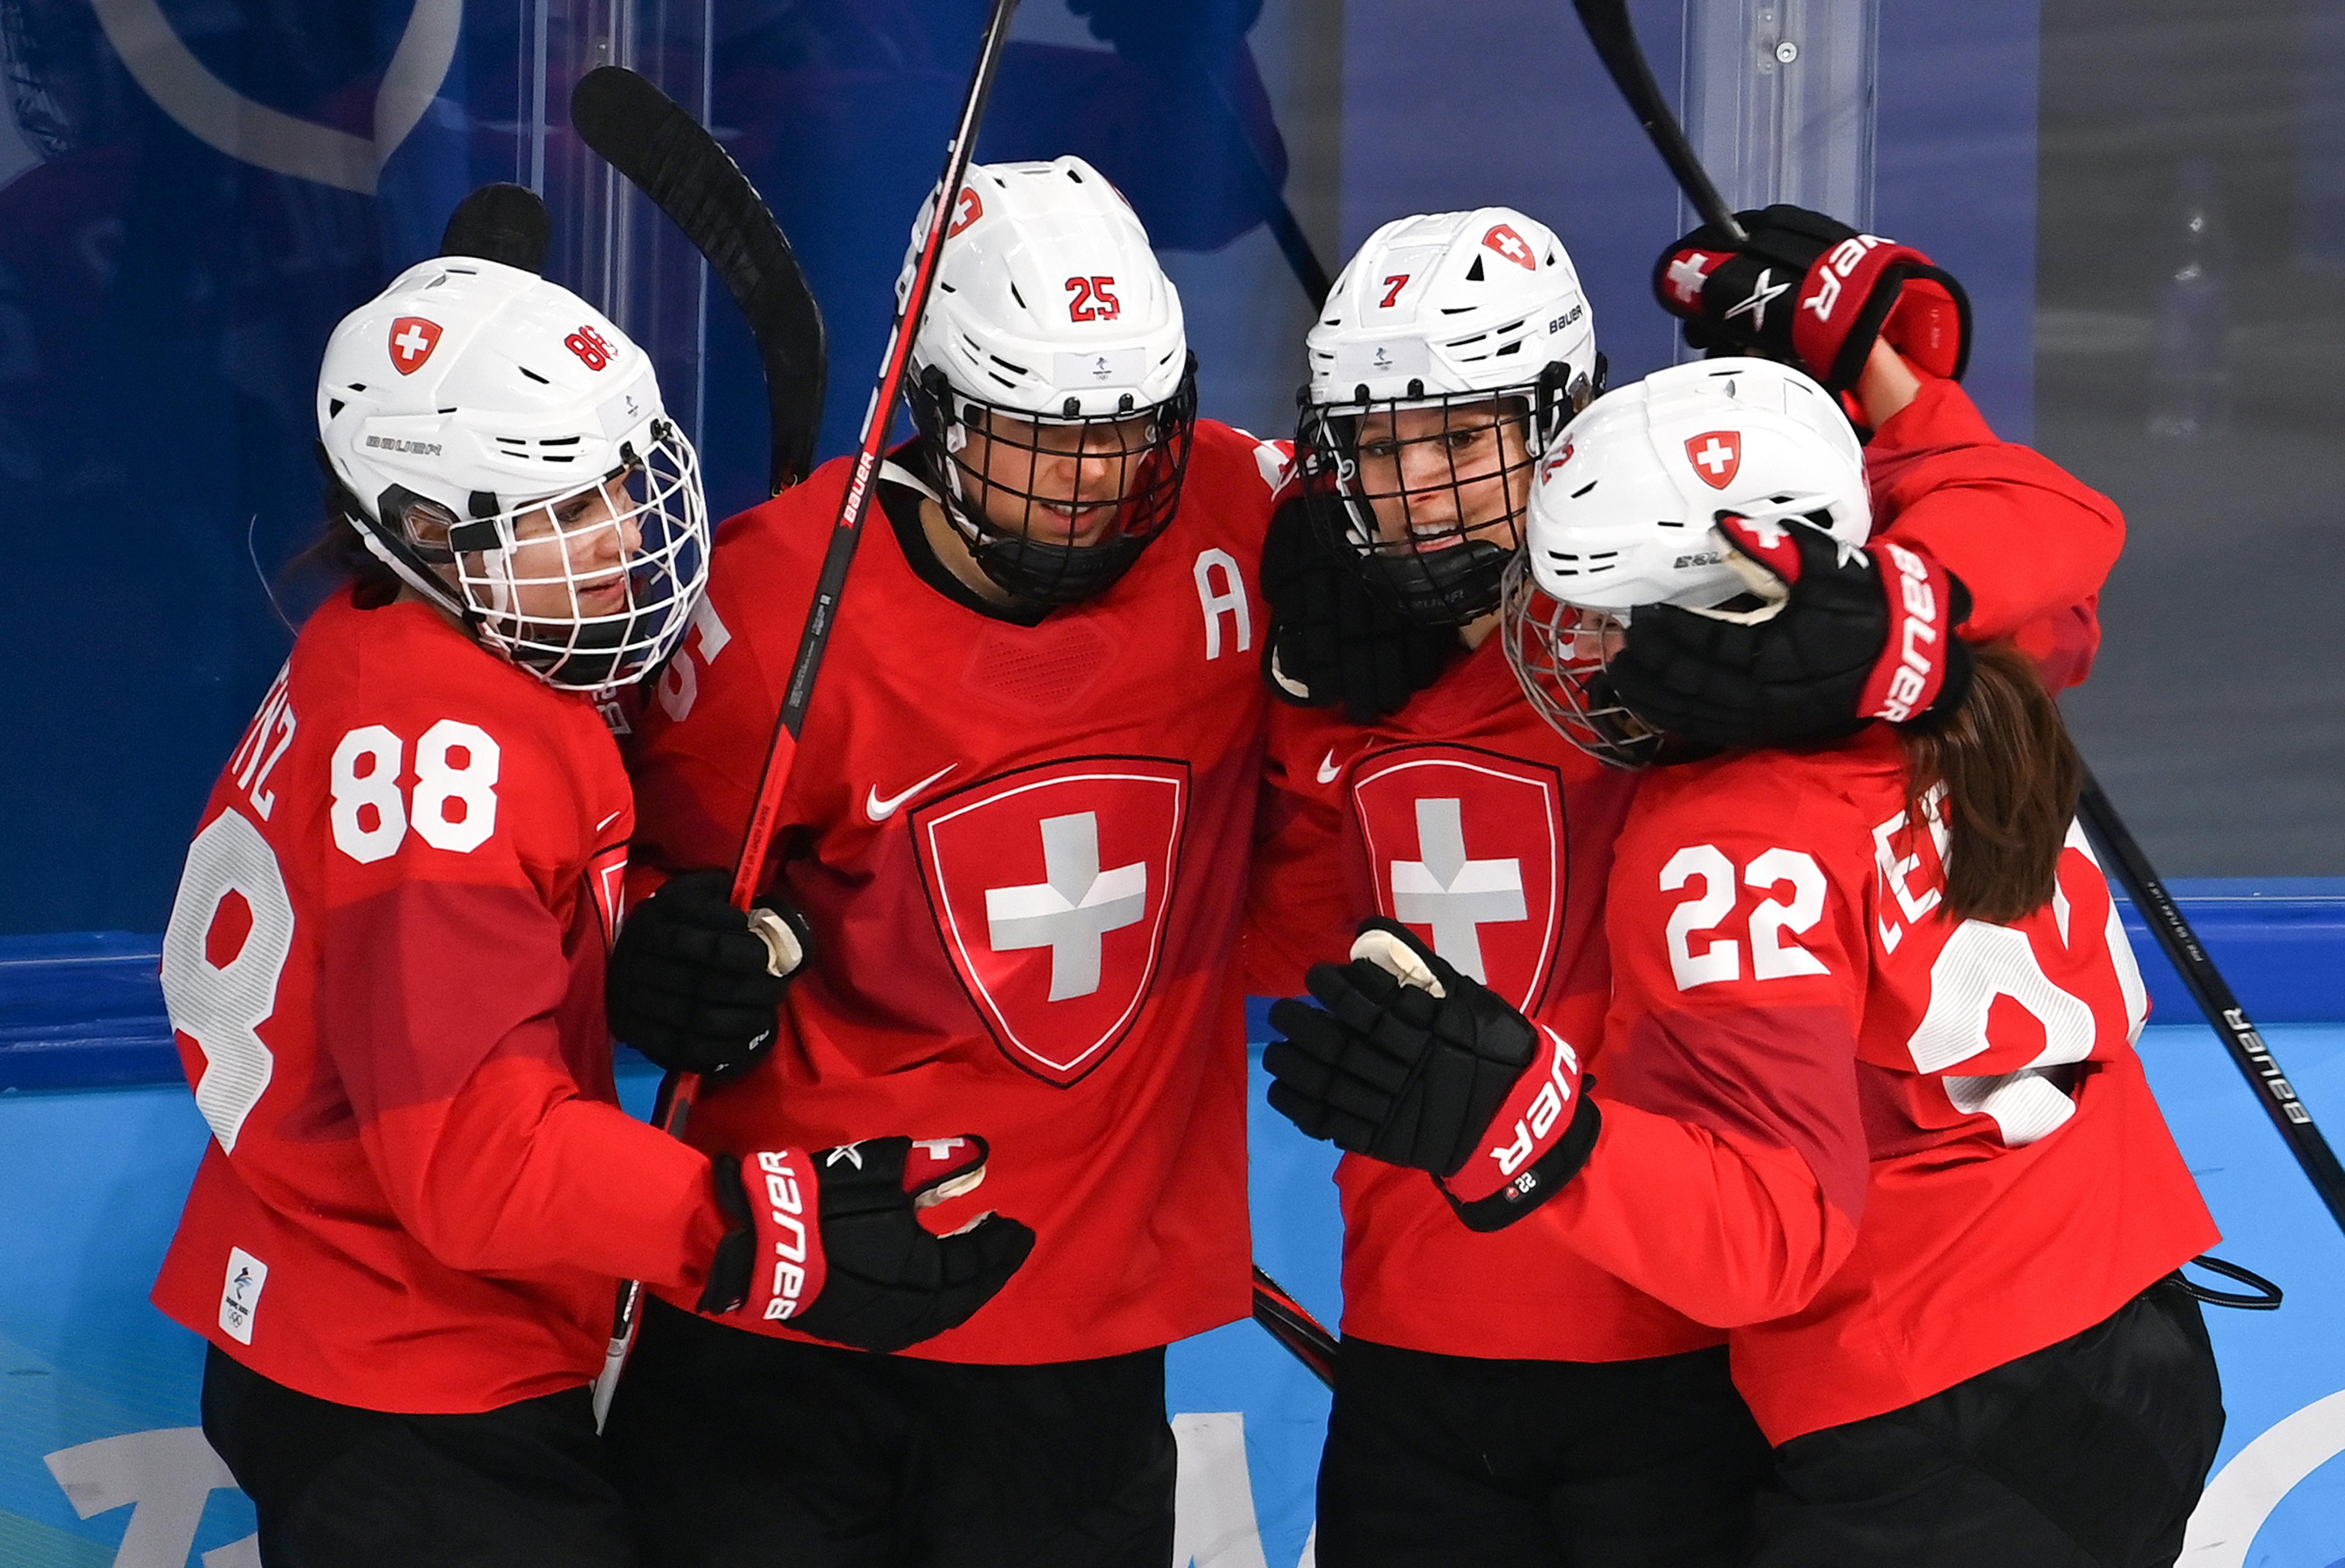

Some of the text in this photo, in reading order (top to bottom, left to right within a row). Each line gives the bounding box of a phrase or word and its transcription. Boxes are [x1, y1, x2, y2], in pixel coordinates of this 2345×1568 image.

[1065, 276, 1121, 322] 25
[1379, 274, 1410, 308] 7
[1549, 305, 1583, 335] BAUER
[843, 451, 875, 524] BAUER
[1193, 547, 1251, 661] A
[330, 718, 500, 864] 88
[1659, 844, 1831, 991] 22
[1490, 1024, 1578, 1175] UER
[2222, 1007, 2313, 1125] BAUER
[762, 1149, 807, 1321] BAUER
[1514, 1171, 1537, 1193] 22
